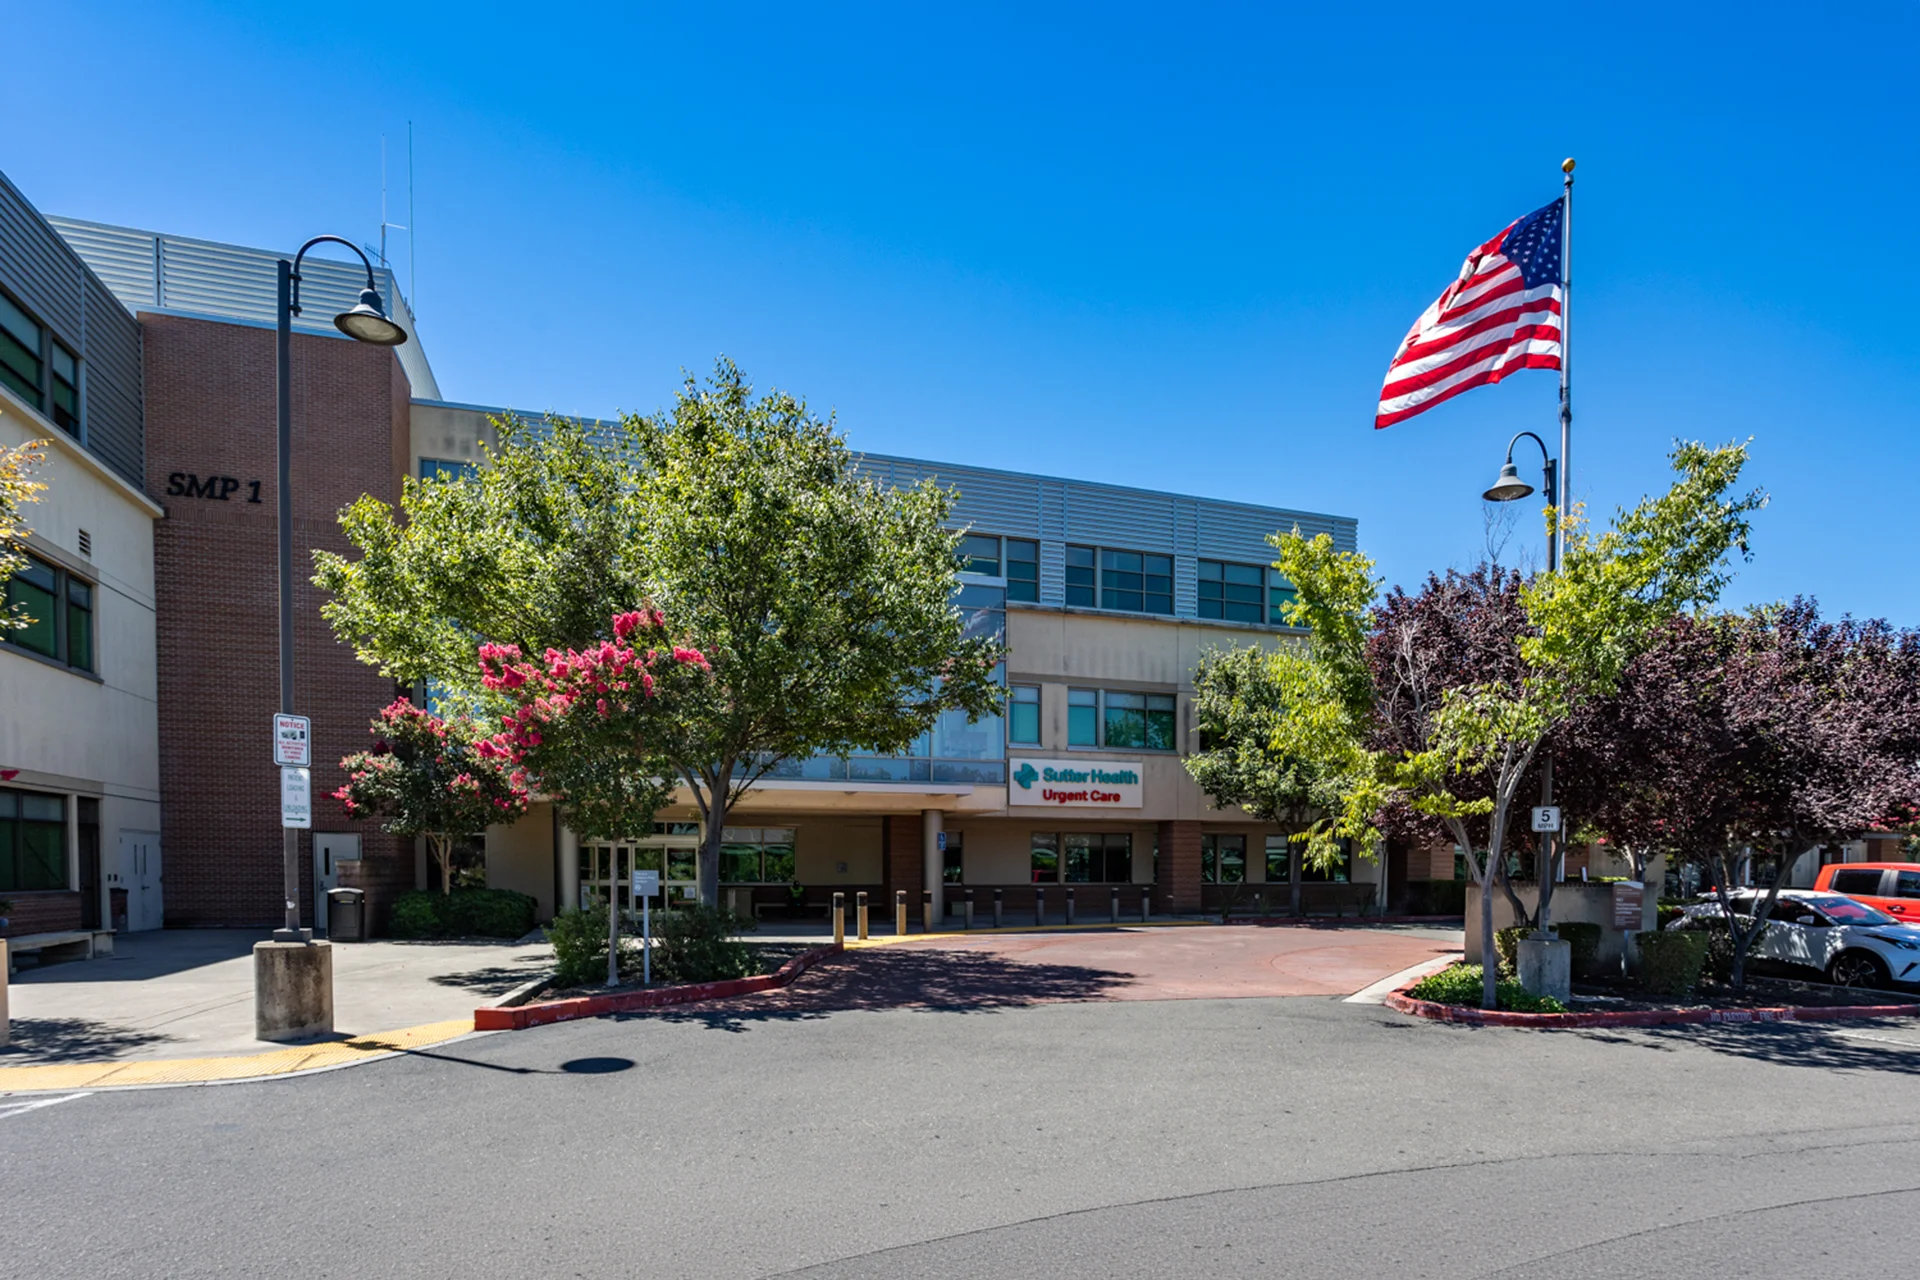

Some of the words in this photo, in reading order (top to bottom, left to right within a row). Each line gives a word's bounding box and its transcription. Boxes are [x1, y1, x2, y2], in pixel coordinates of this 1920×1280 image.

[167, 472, 239, 501] SMP
[247, 480, 262, 504] 1
[279, 720, 305, 730] NOTICE
[1042, 767, 1090, 782] Sutter
[1091, 768, 1139, 785] Health
[1042, 788, 1089, 804] Urgent
[1090, 790, 1121, 802] Care
[1541, 809, 1551, 822] 5
